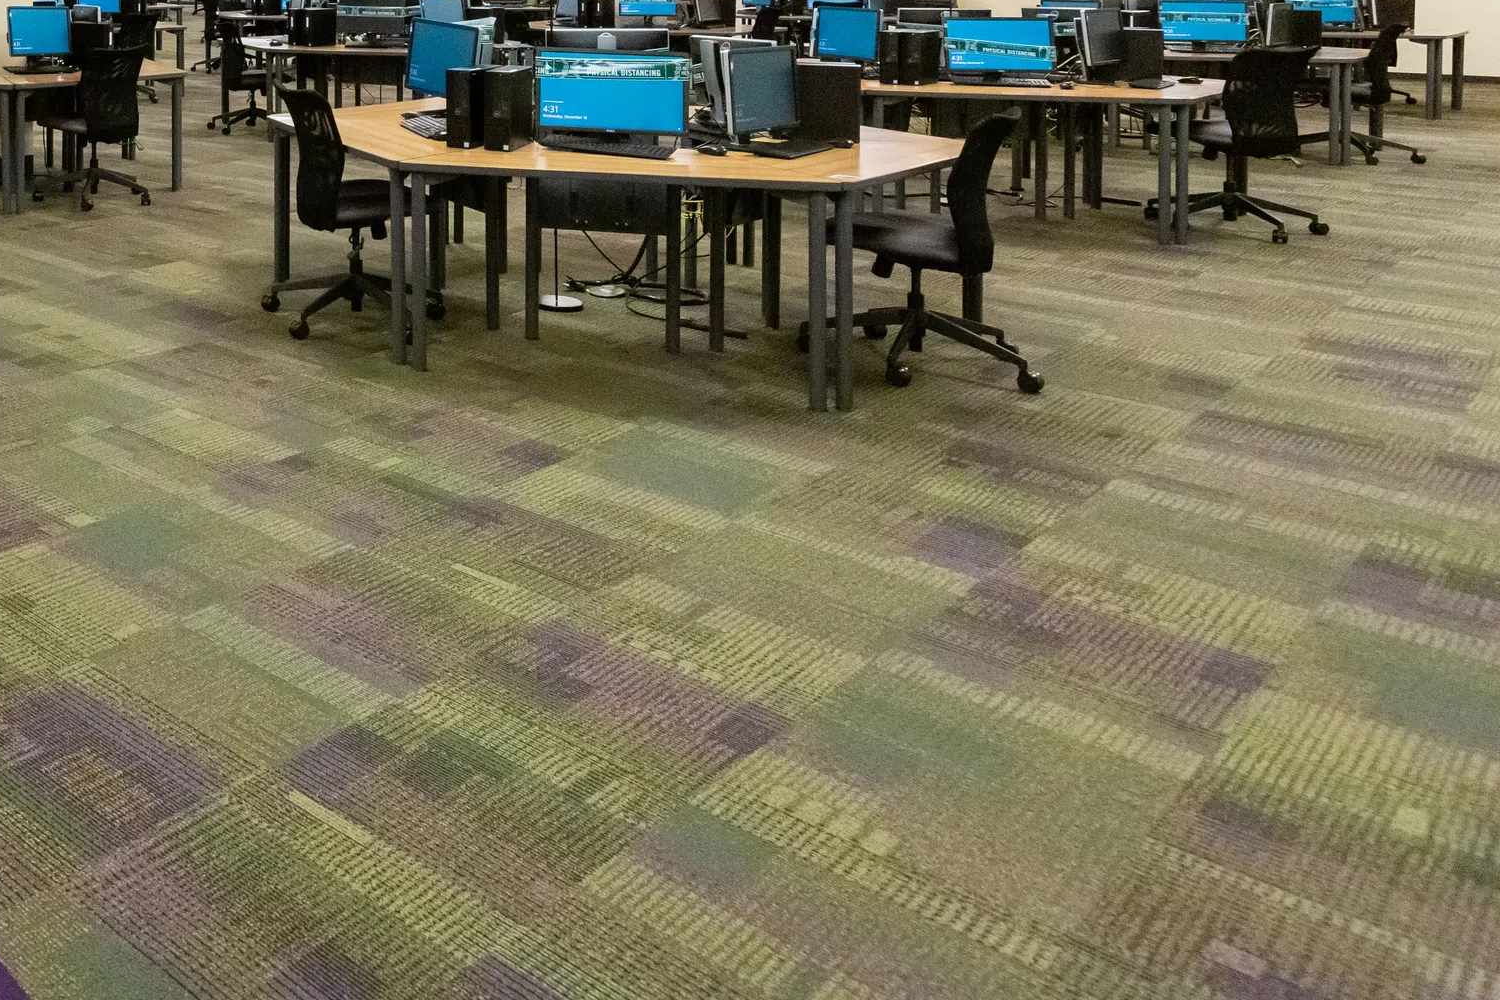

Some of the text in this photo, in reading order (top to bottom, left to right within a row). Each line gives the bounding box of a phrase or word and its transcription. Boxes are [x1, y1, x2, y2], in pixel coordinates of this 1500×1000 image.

[982, 47, 1037, 58] PHYSICAL DISTANCING
[586, 68, 662, 77] PHYSICAL DISTANCING
[543, 105, 559, 113] 4:31
